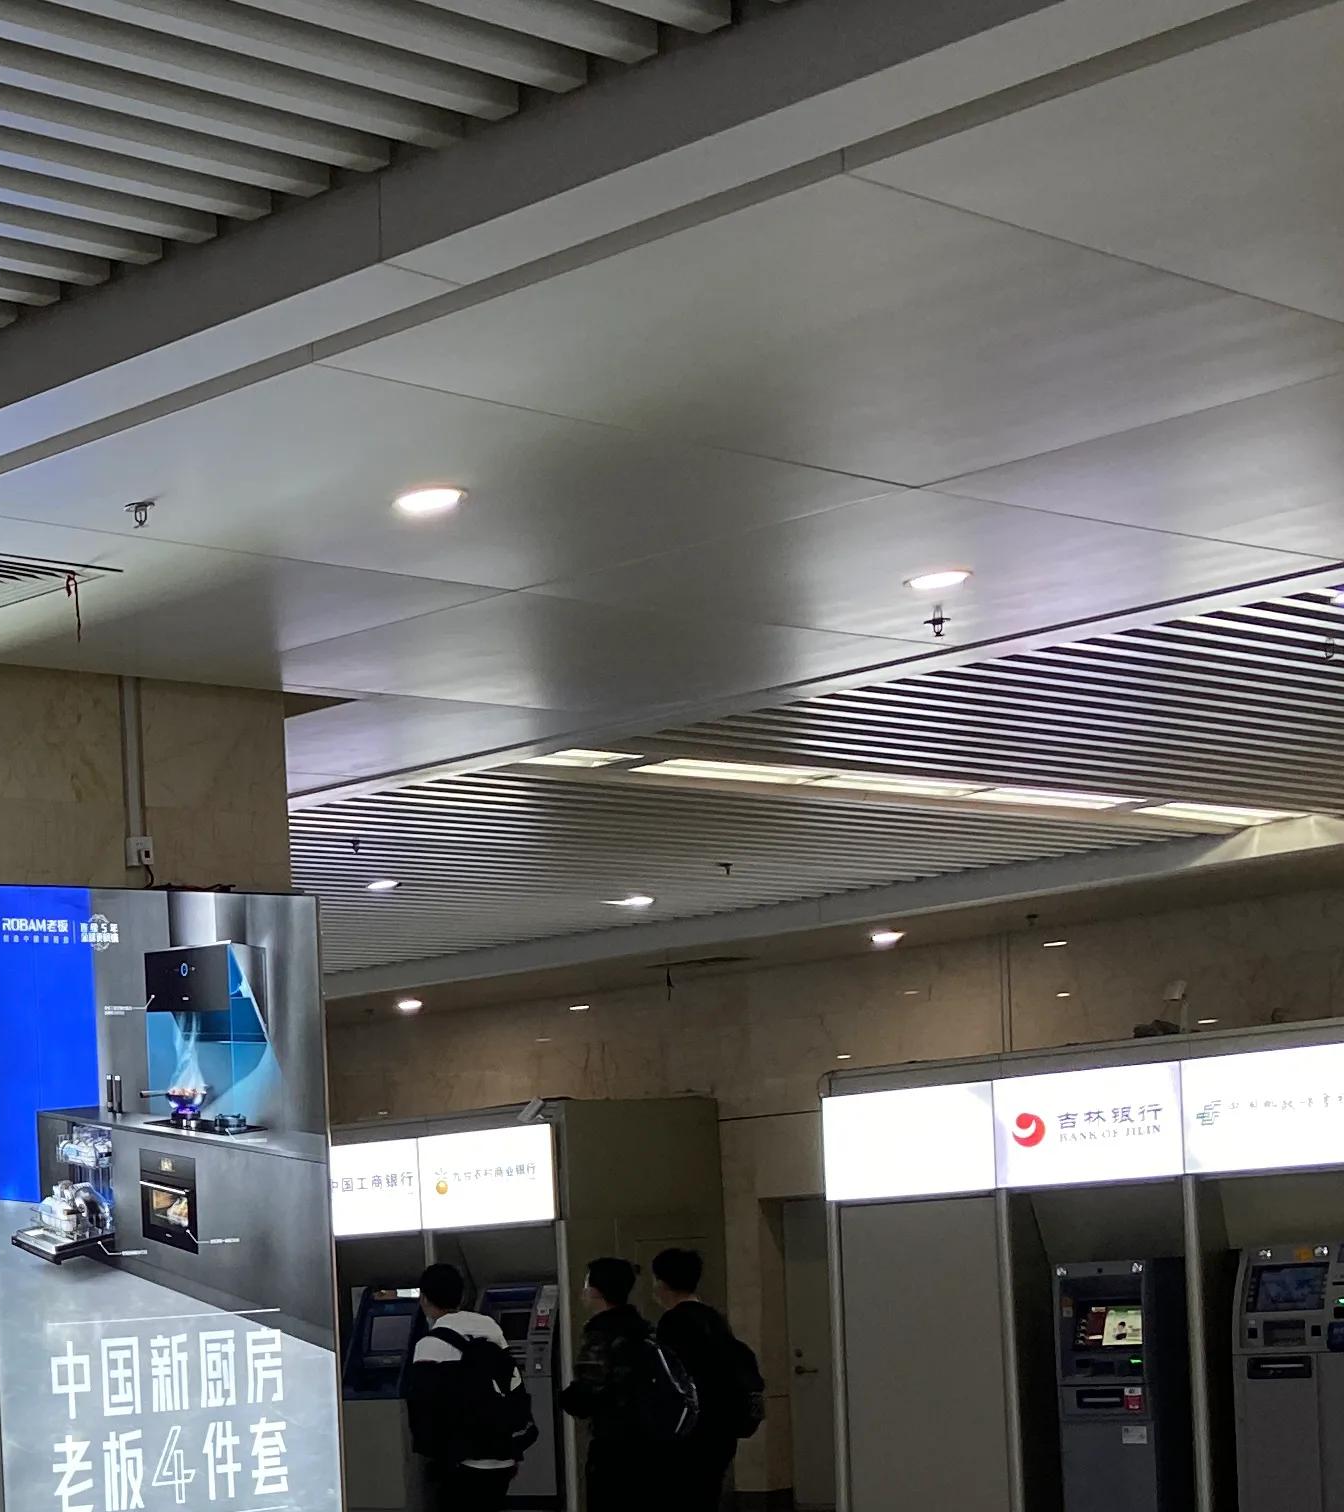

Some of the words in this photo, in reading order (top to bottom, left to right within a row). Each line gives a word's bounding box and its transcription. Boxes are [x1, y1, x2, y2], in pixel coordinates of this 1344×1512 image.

[1056, 1103, 1163, 1130] 吉林银行
[1124, 1124, 1162, 1137] JILIN
[50, 1328, 285, 1420] 中国新厨房
